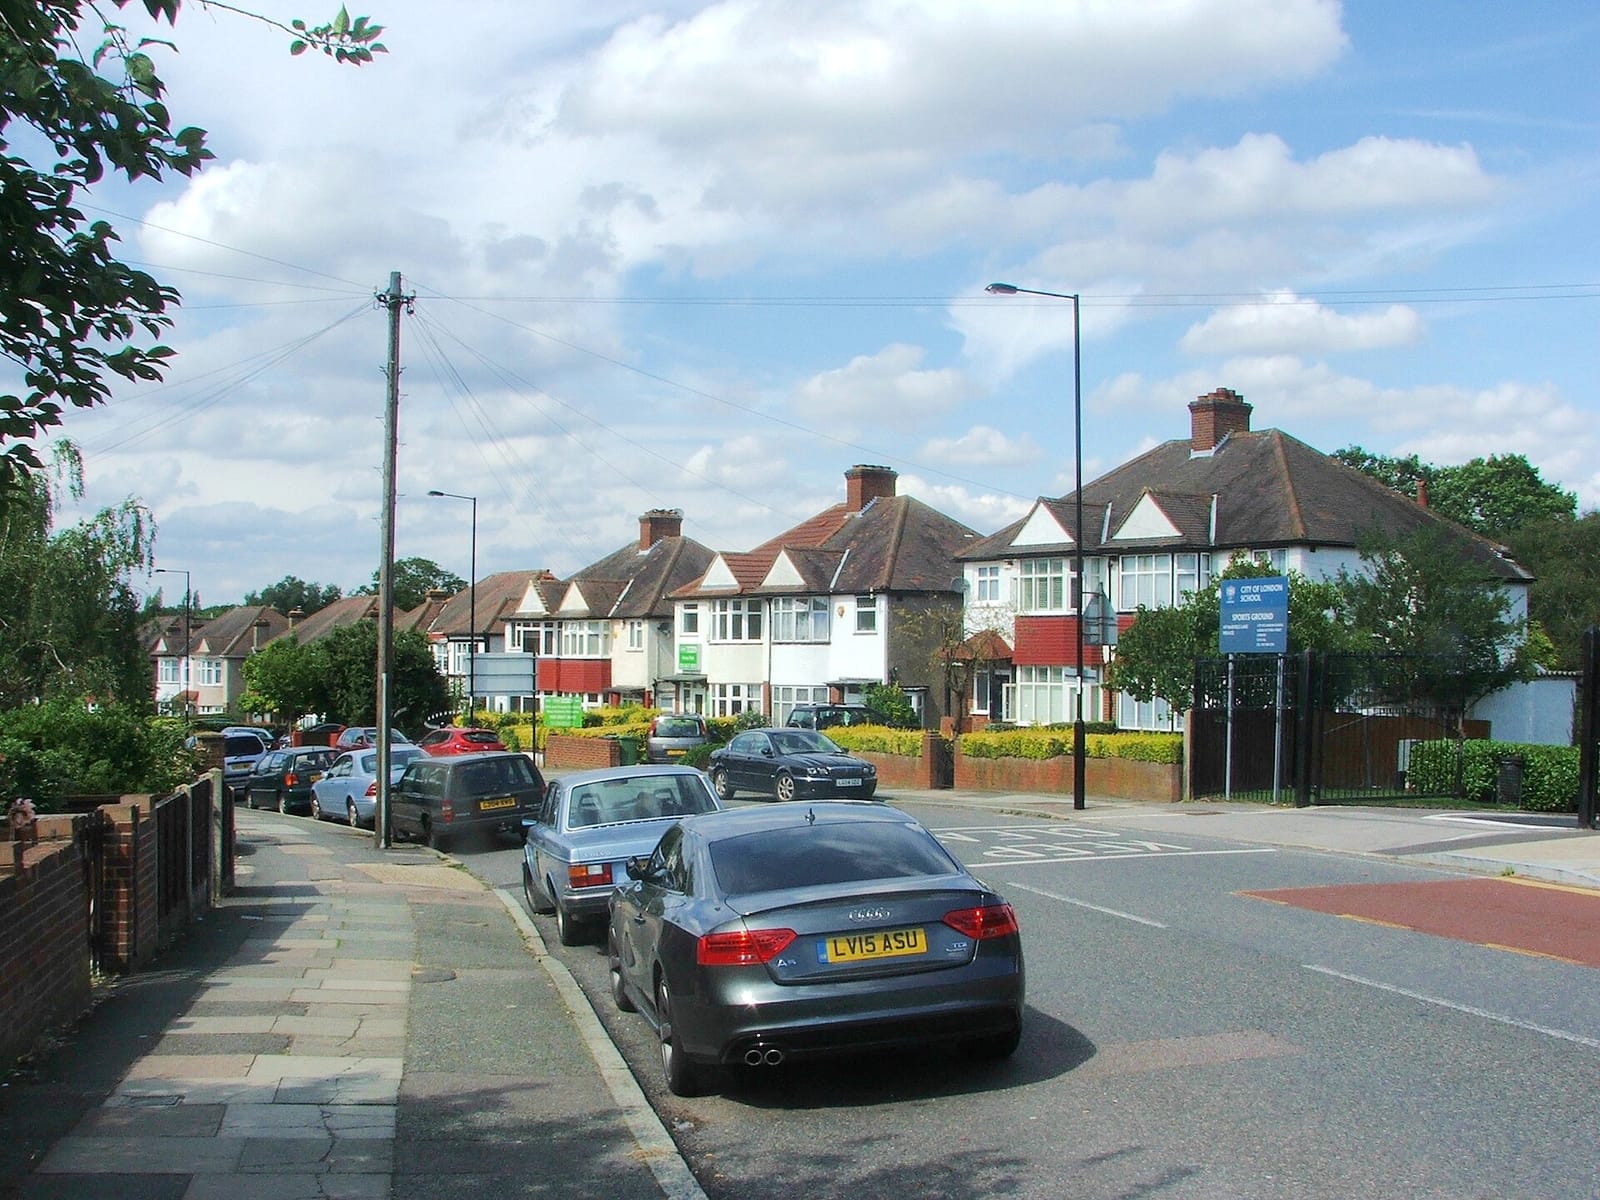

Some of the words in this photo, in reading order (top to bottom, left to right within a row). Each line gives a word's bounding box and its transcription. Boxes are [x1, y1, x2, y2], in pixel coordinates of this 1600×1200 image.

[1240, 585, 1252, 594] CITY
[1252, 585, 1260, 593] OF
[1260, 584, 1283, 593] LONDON
[1240, 594, 1261, 602] SCHOOL
[1231, 613, 1250, 621] SPORTS
[1250, 612, 1274, 621] GROUND
[983, 840, 1192, 857] KEEP
[833, 935, 876, 957] LV15
[882, 931, 918, 952] ASU
